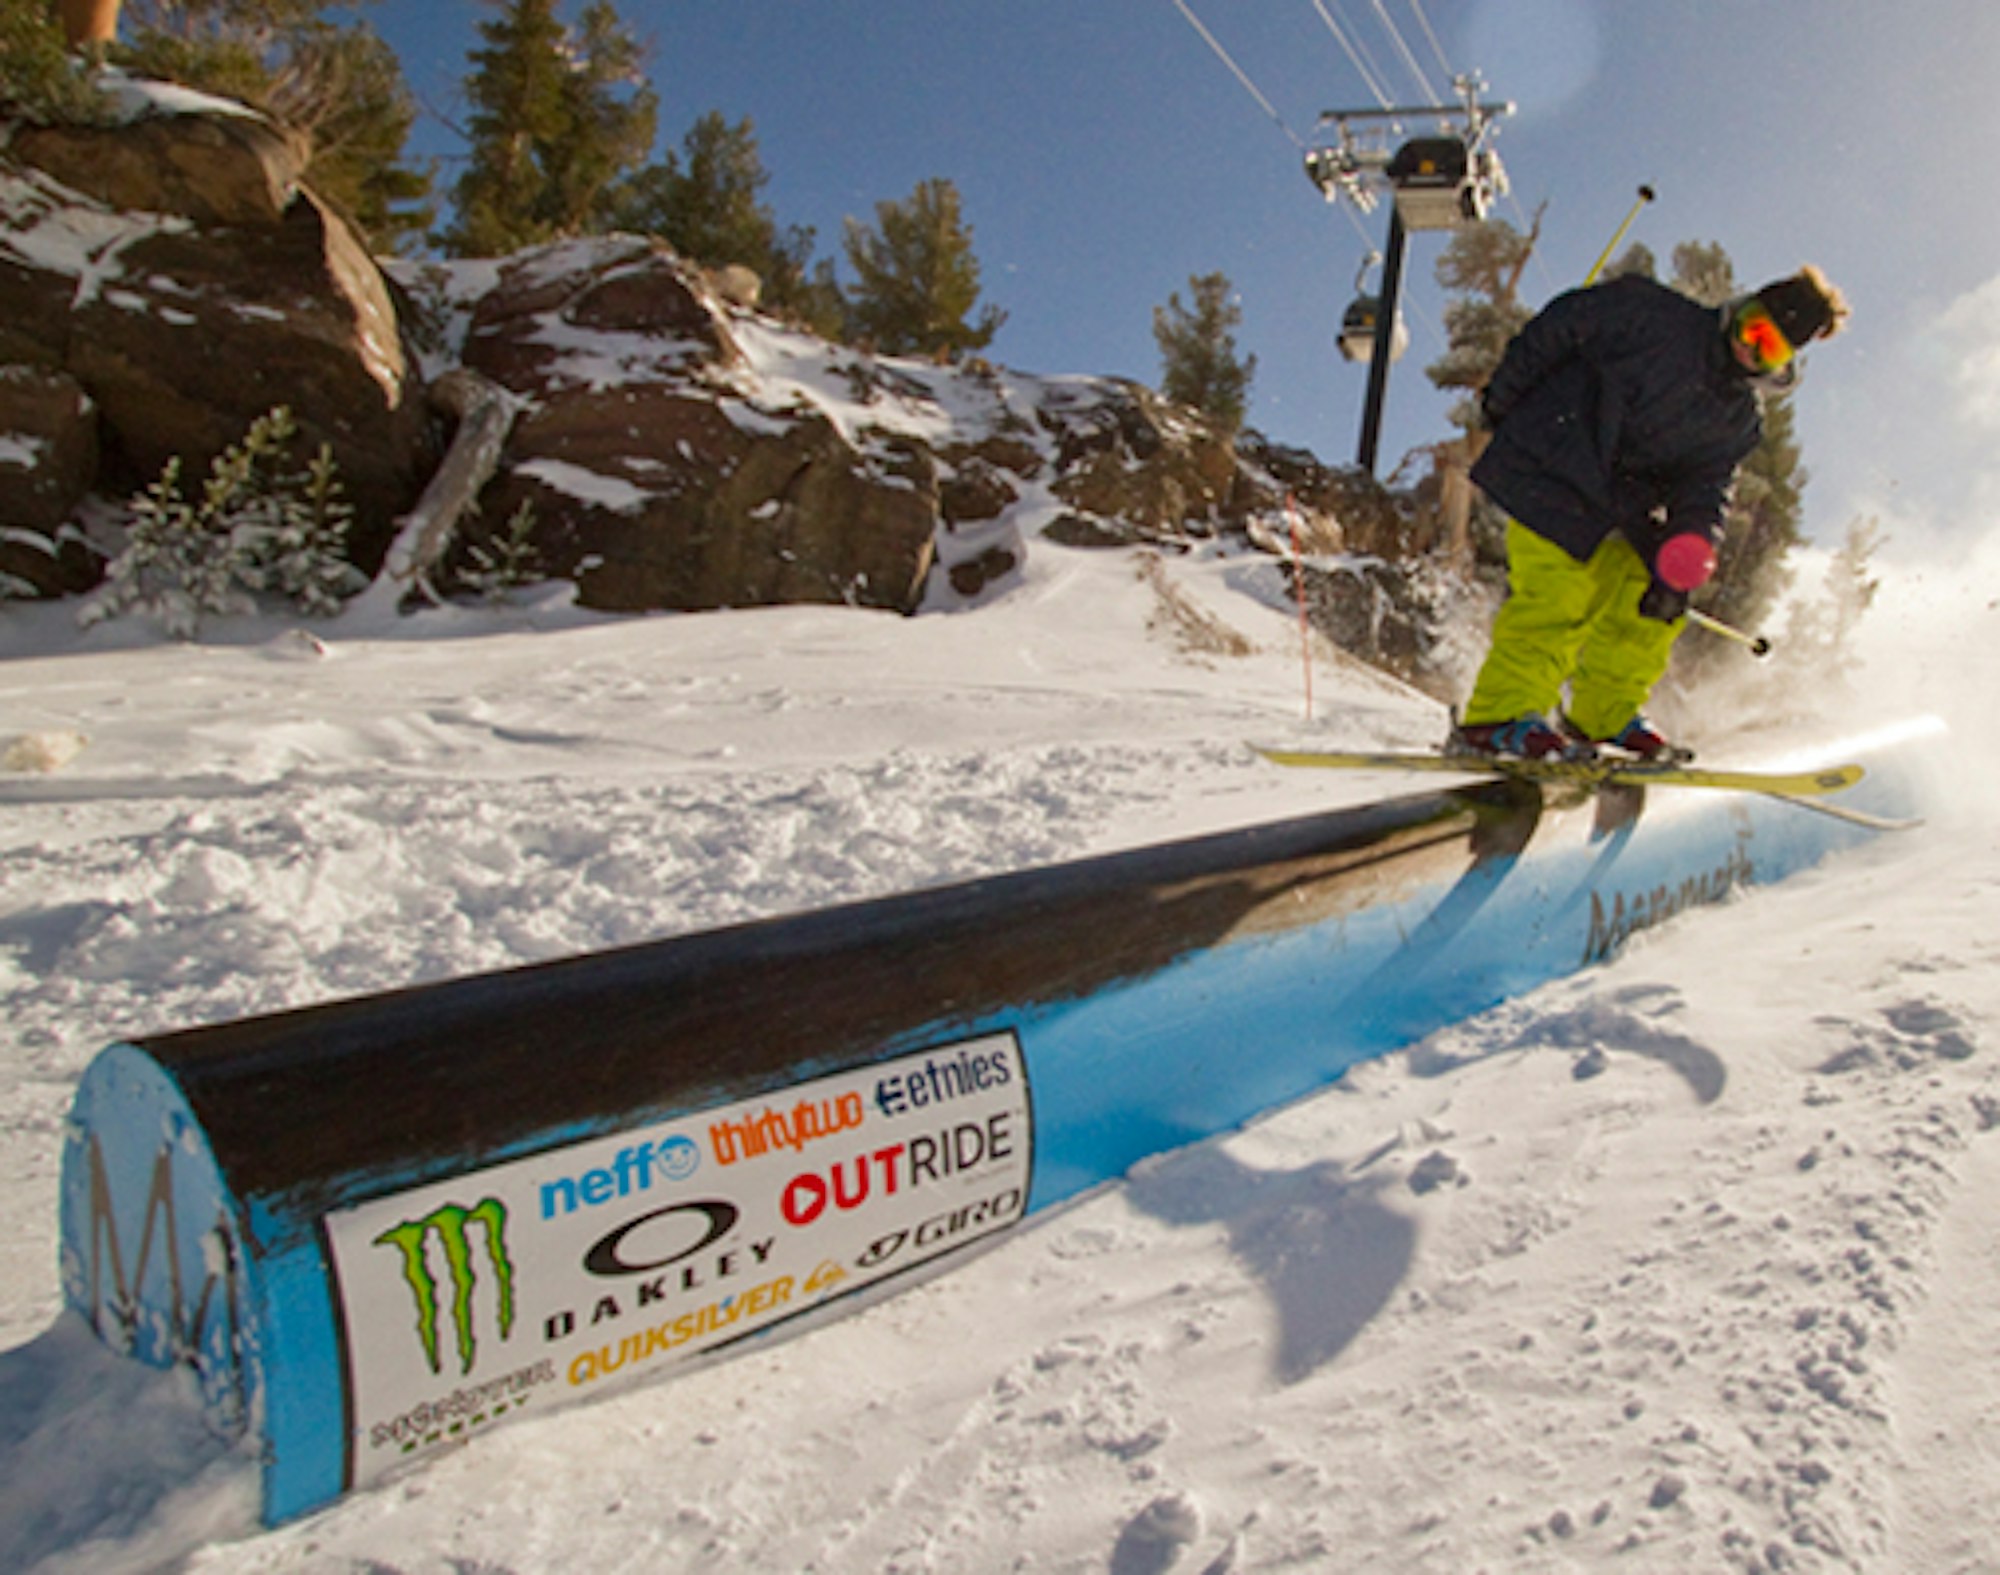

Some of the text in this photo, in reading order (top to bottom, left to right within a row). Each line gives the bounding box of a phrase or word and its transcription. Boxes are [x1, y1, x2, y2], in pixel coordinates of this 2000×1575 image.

[709, 1091, 865, 1167] thirtytwo
[780, 1112, 1012, 1227] OUTRIDE
[539, 1138, 657, 1220] neff
[912, 1189, 1020, 1249] GIRO
[543, 1237, 777, 1343] OAKLEY
[567, 1275, 796, 1387] QUIKSILVER
